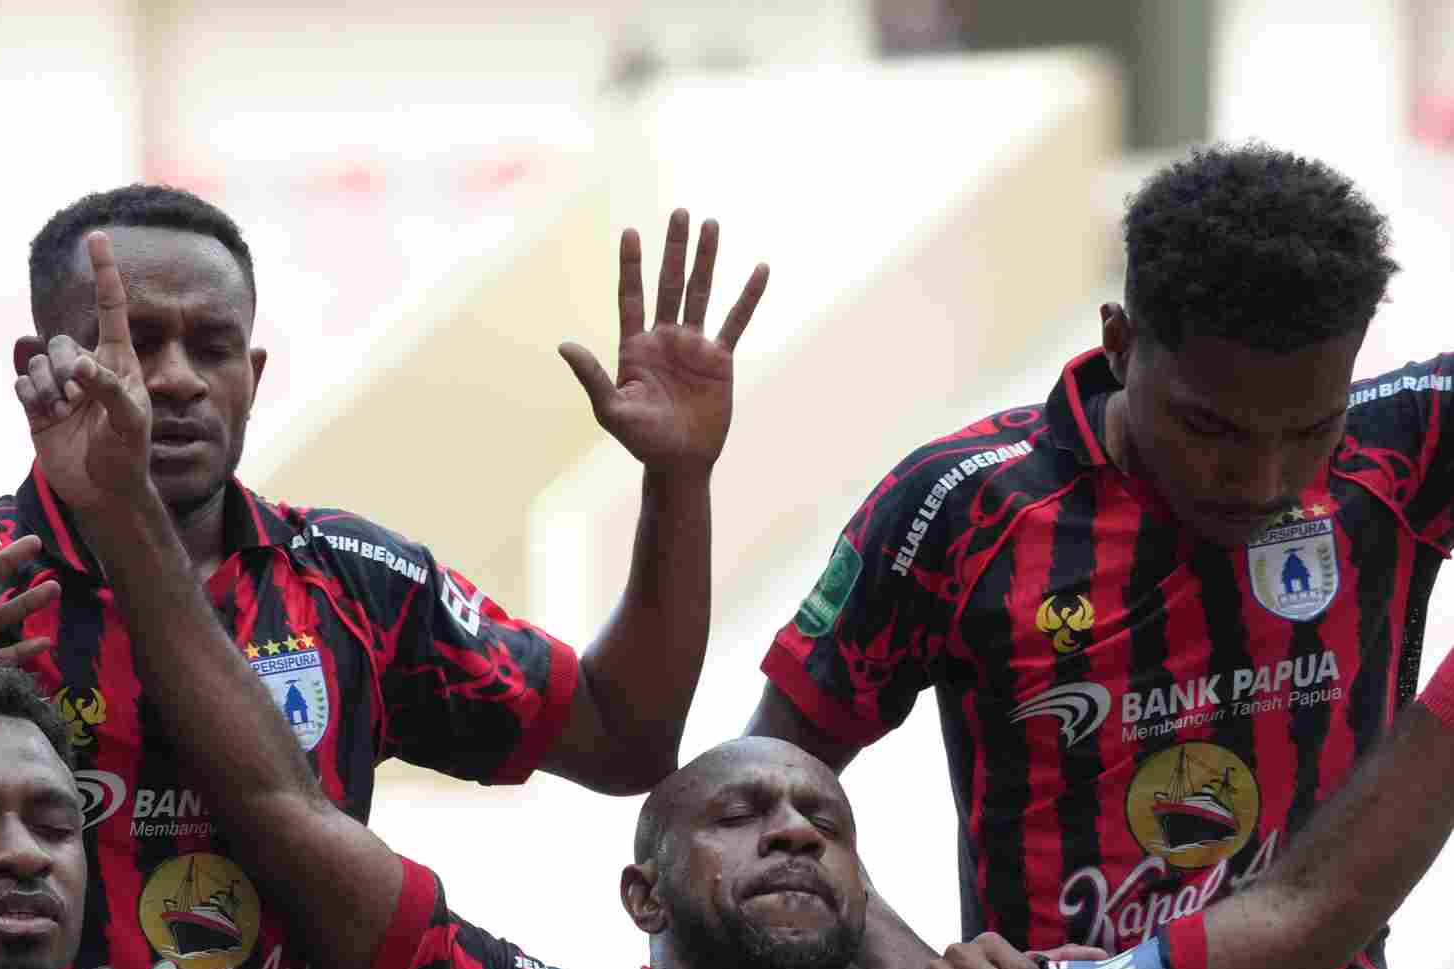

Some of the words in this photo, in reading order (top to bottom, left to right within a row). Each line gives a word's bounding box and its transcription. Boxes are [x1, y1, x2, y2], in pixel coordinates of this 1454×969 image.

[1378, 373, 1452, 398] BERANI
[890, 517, 930, 577] JELAS
[923, 468, 965, 521] LEBIH
[960, 440, 1034, 477] BERANI
[360, 542, 429, 585] BERANI
[1121, 673, 1221, 724] BANK
[1231, 650, 1341, 701] PAPUA
[1122, 709, 1225, 743] Membangun
[1232, 695, 1283, 716] Tanah
[1288, 686, 1342, 710] Papua
[133, 789, 211, 819] BAN
